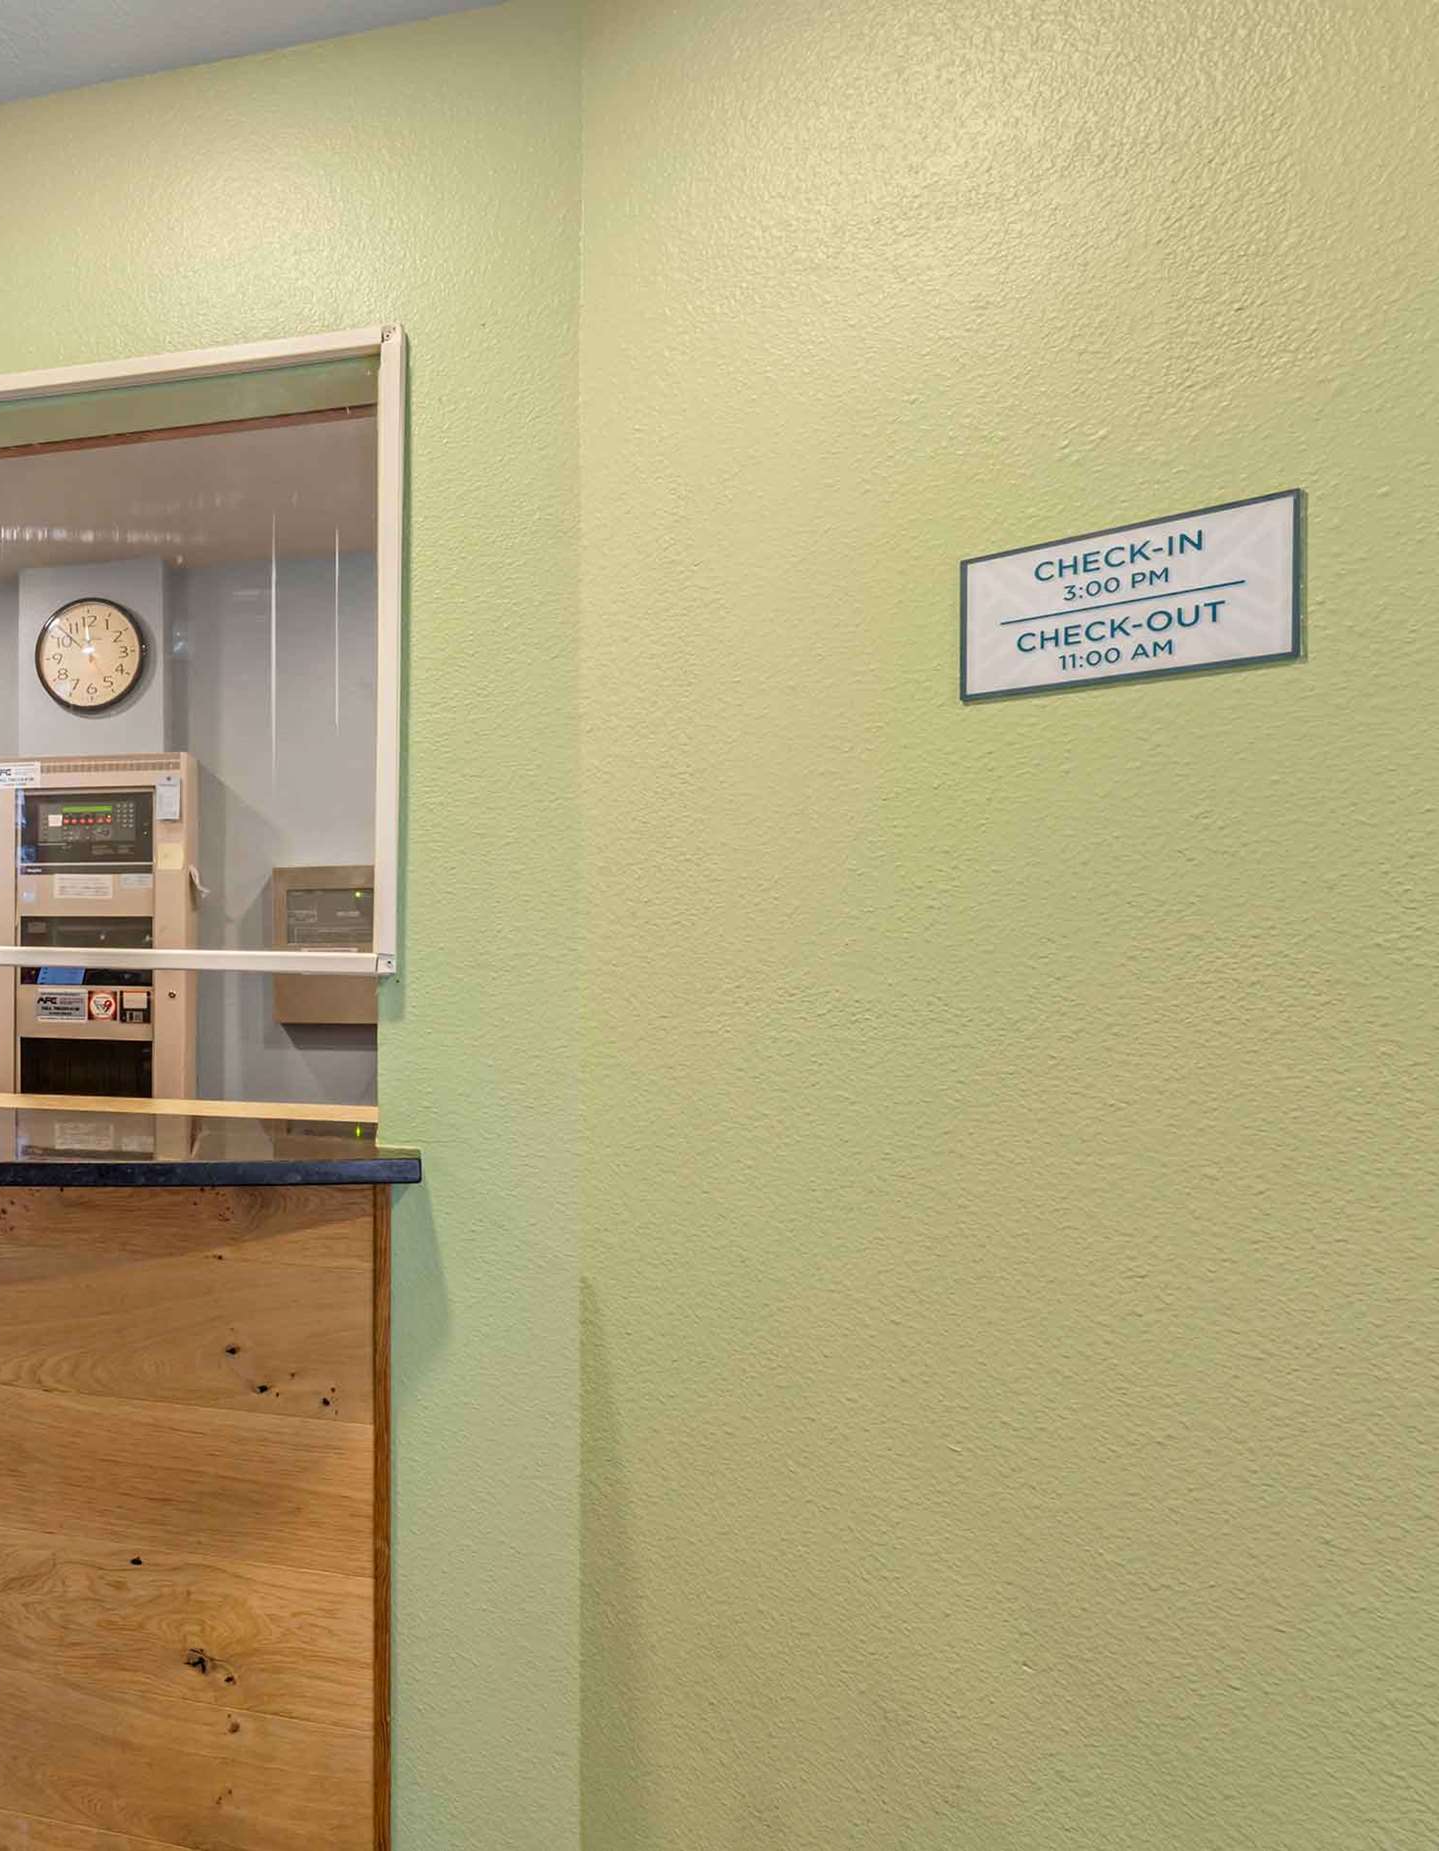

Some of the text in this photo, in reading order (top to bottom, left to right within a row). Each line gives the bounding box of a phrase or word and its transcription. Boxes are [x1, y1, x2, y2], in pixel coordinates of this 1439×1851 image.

[1033, 529, 1204, 582] CHECK-IN
[1063, 567, 1170, 601] 3:00 PM
[68, 621, 79, 634] 11
[82, 615, 97, 628] 12
[1016, 600, 1226, 652] CHECK-OUT
[56, 637, 72, 649] 10
[112, 630, 123, 643] 2
[52, 653, 63, 665] 9
[119, 646, 129, 659] 3
[1059, 639, 1174, 671] 11:00 AM
[57, 668, 68, 680] 8
[115, 663, 124, 675] 4
[71, 678, 80, 690] 7
[103, 675, 113, 688] 5
[86, 683, 97, 695] 6
